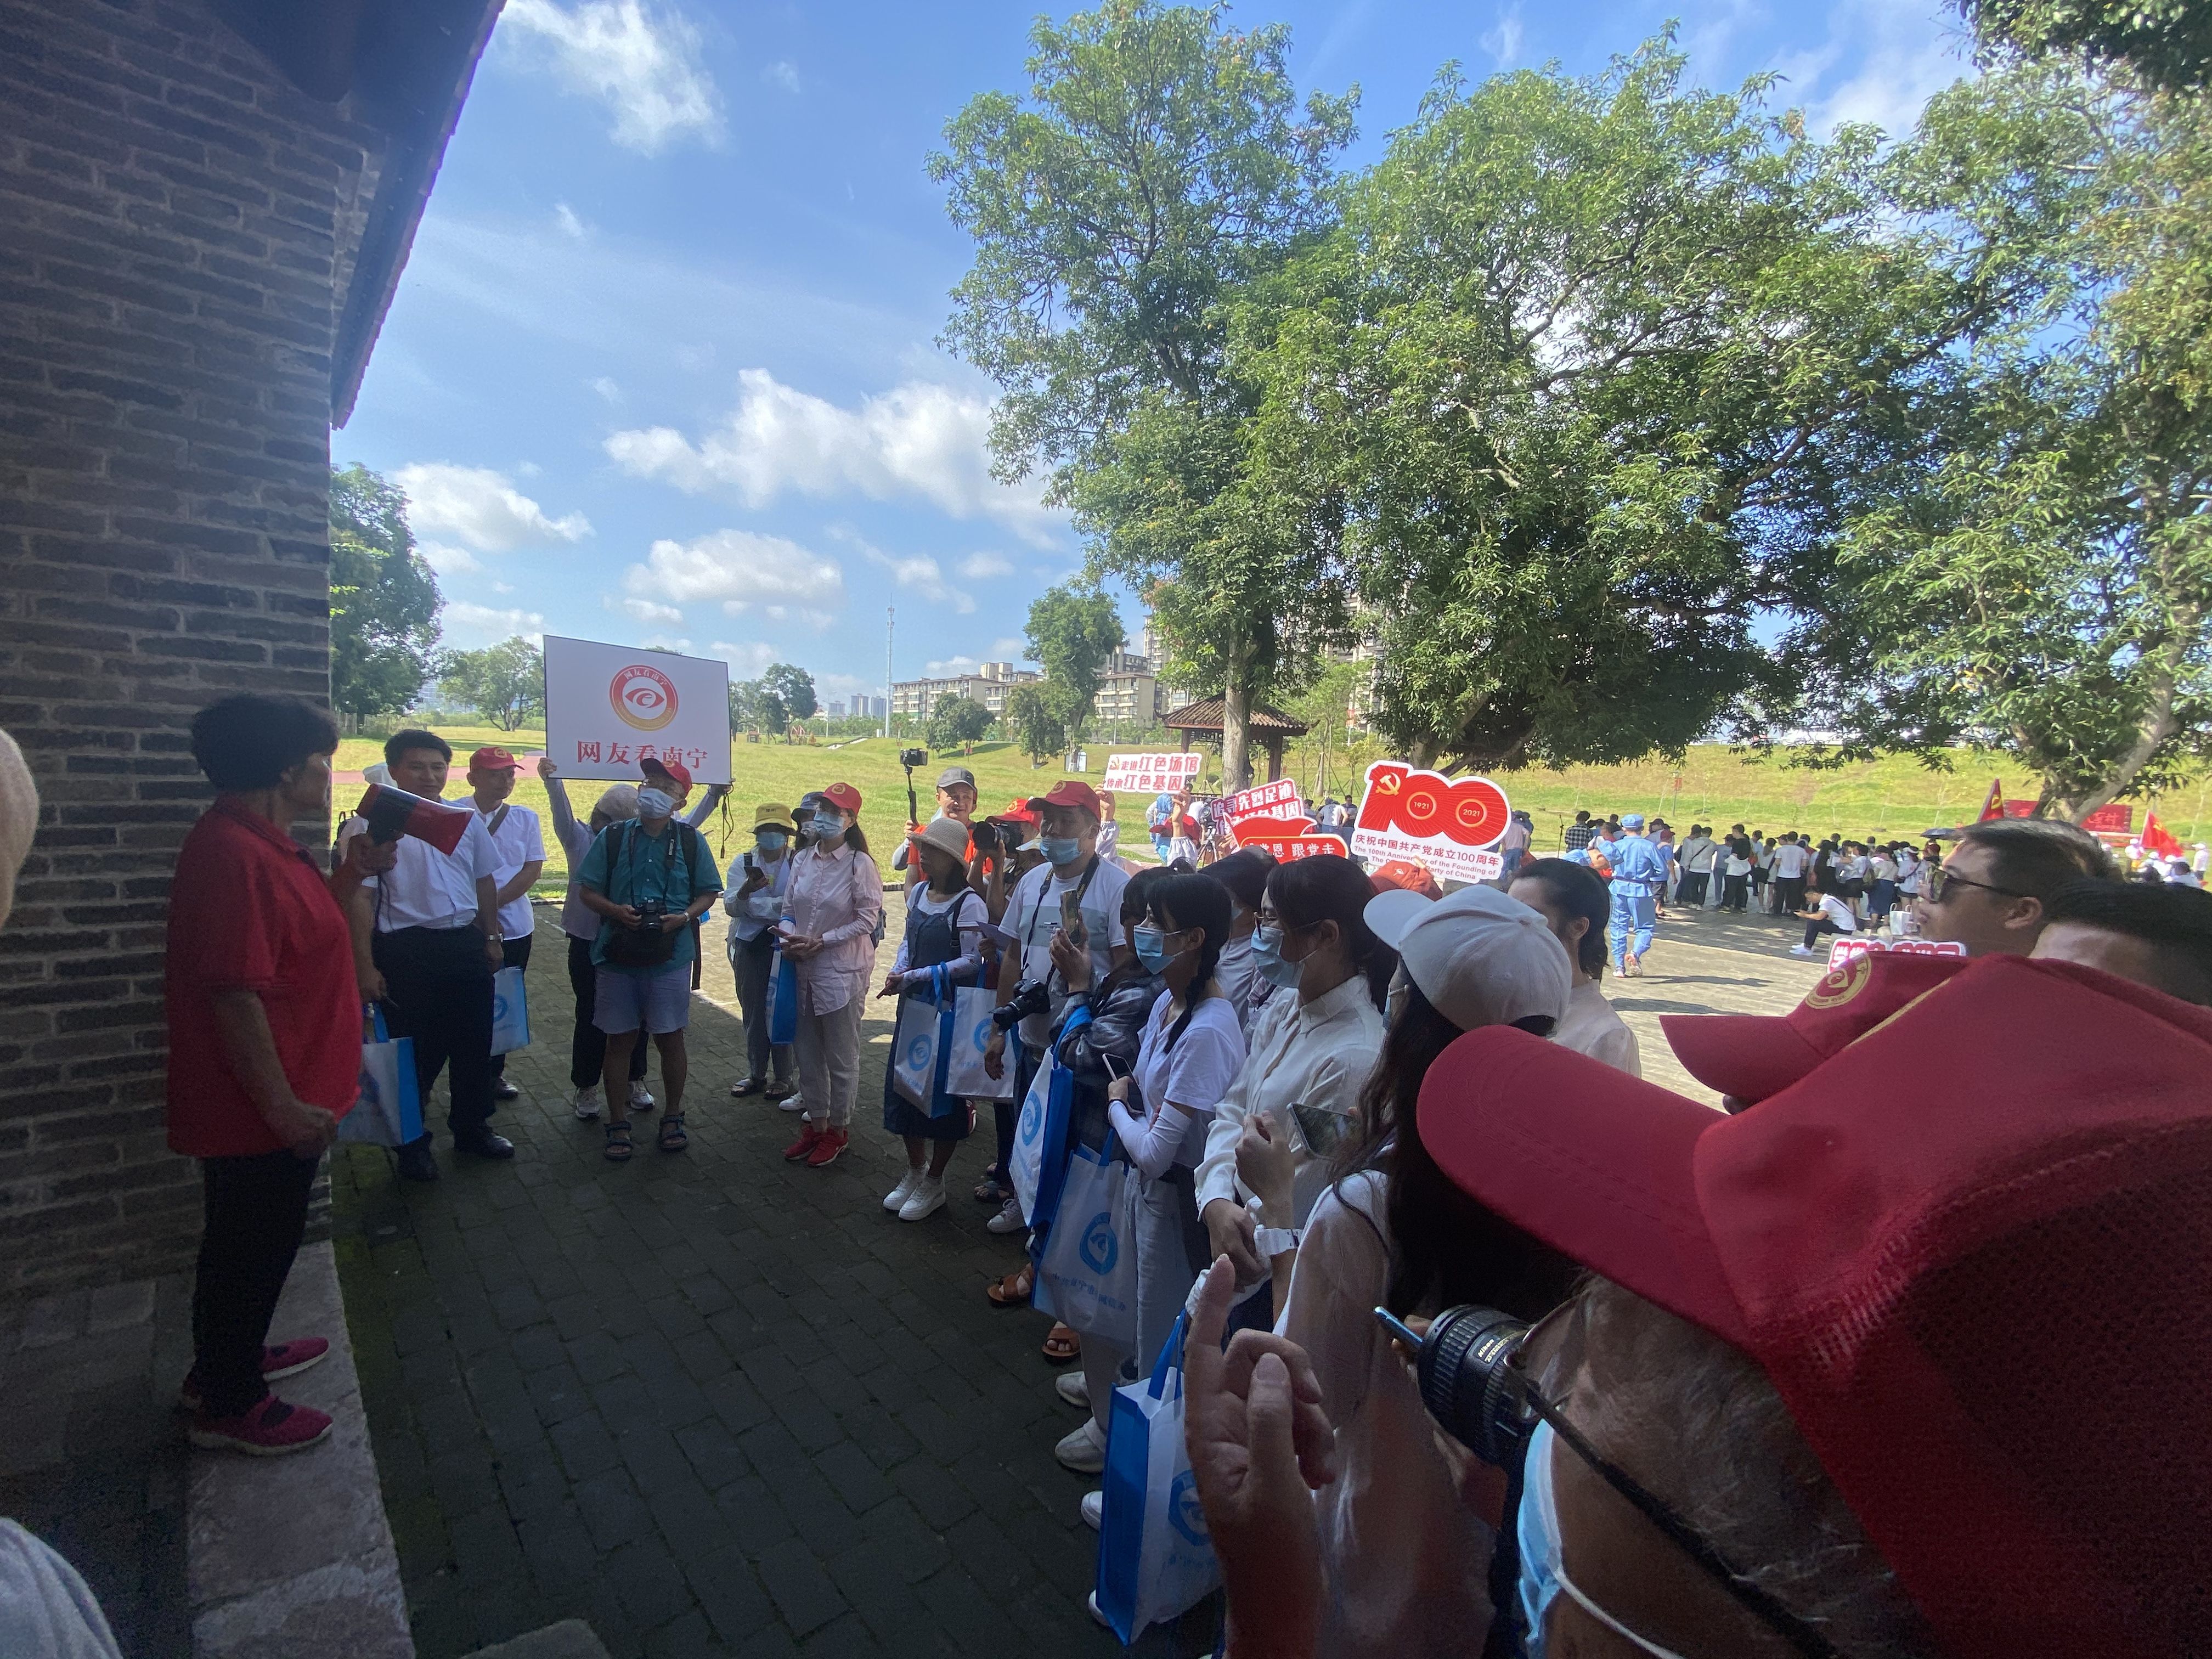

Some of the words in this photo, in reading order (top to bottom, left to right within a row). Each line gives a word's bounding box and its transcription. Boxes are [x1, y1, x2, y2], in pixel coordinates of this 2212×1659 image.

[578, 740, 708, 769] 网友看南宁
[1121, 756, 1199, 772] 走进红色场馆
[1107, 774, 1182, 791] 传承红色基因
[1214, 782, 1293, 817] 追寻先烈足迹
[1414, 801, 1430, 809] 1921
[1463, 809, 1480, 817] 2021
[1245, 843, 1284, 857] 党恩
[1291, 843, 1335, 857] 跟党走
[1356, 834, 1499, 866] 庆祝中国共产党成立100周年
[1387, 851, 1428, 865] Anniverry
[1452, 863, 1486, 875] Founding
[1455, 871, 1476, 879] China
[1477, 1339, 1494, 1357] Nikon
